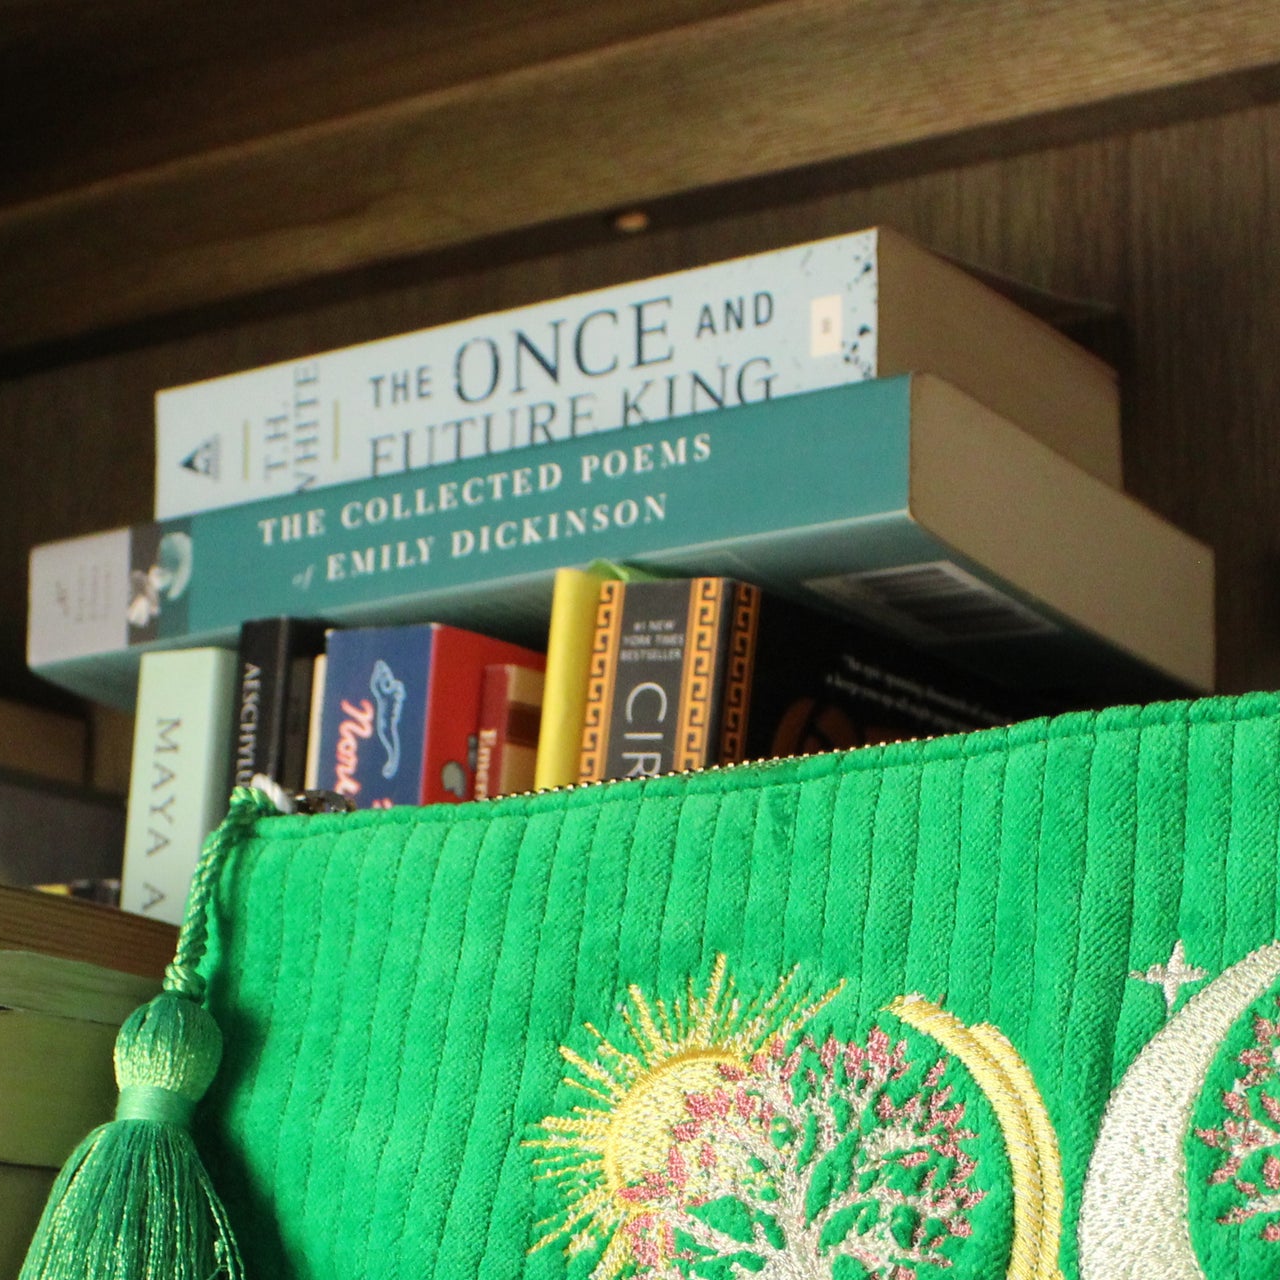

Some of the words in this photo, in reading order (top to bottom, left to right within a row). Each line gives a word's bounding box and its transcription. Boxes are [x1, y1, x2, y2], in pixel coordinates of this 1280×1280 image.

[369, 364, 433, 408] THE
[453, 295, 676, 405] ONCE
[696, 290, 775, 340] AND
[370, 392, 600, 479] FUTURE
[621, 357, 781, 432] KING
[257, 509, 327, 547] THE
[341, 462, 563, 530] COLLECTED
[580, 433, 713, 485] POEMS
[292, 565, 315, 592] of
[325, 537, 437, 582] EMILY
[451, 493, 668, 558] DICKINSON
[146, 716, 181, 858] MAYA
